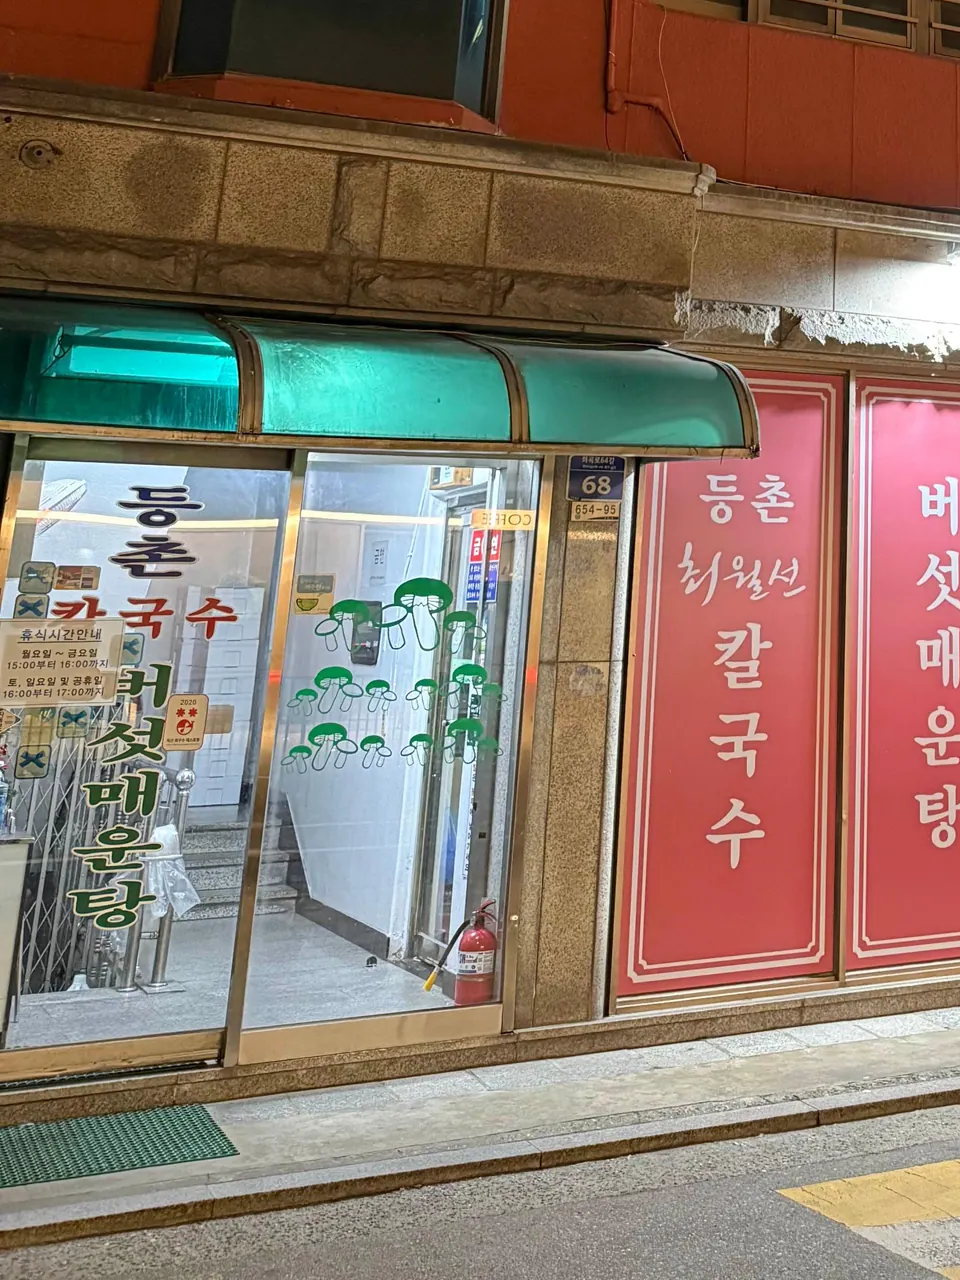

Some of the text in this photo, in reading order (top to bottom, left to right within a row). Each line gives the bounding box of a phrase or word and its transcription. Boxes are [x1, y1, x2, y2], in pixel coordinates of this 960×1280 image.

[582, 475, 612, 495] 68
[699, 473, 795, 524] 등촌
[575, 504, 616, 515] 654-95
[110, 486, 204, 578] 등촌
[677, 541, 806, 607] 최월선
[20, 628, 102, 641] 휴식시간안내
[22, 649, 52, 659] 월요일
[68, 648, 98, 658] 금요일
[7, 659, 109, 670] 15:00부터 16:00까지
[26, 677, 56, 687] 일요일
[60, 677, 69, 687] 및
[73, 675, 103, 686] 공휴일
[3, 687, 105, 699] 16:00부터 17:00까지
[706, 621, 773, 870] 칼국수
[66, 663, 173, 929] 버섯매운탕
